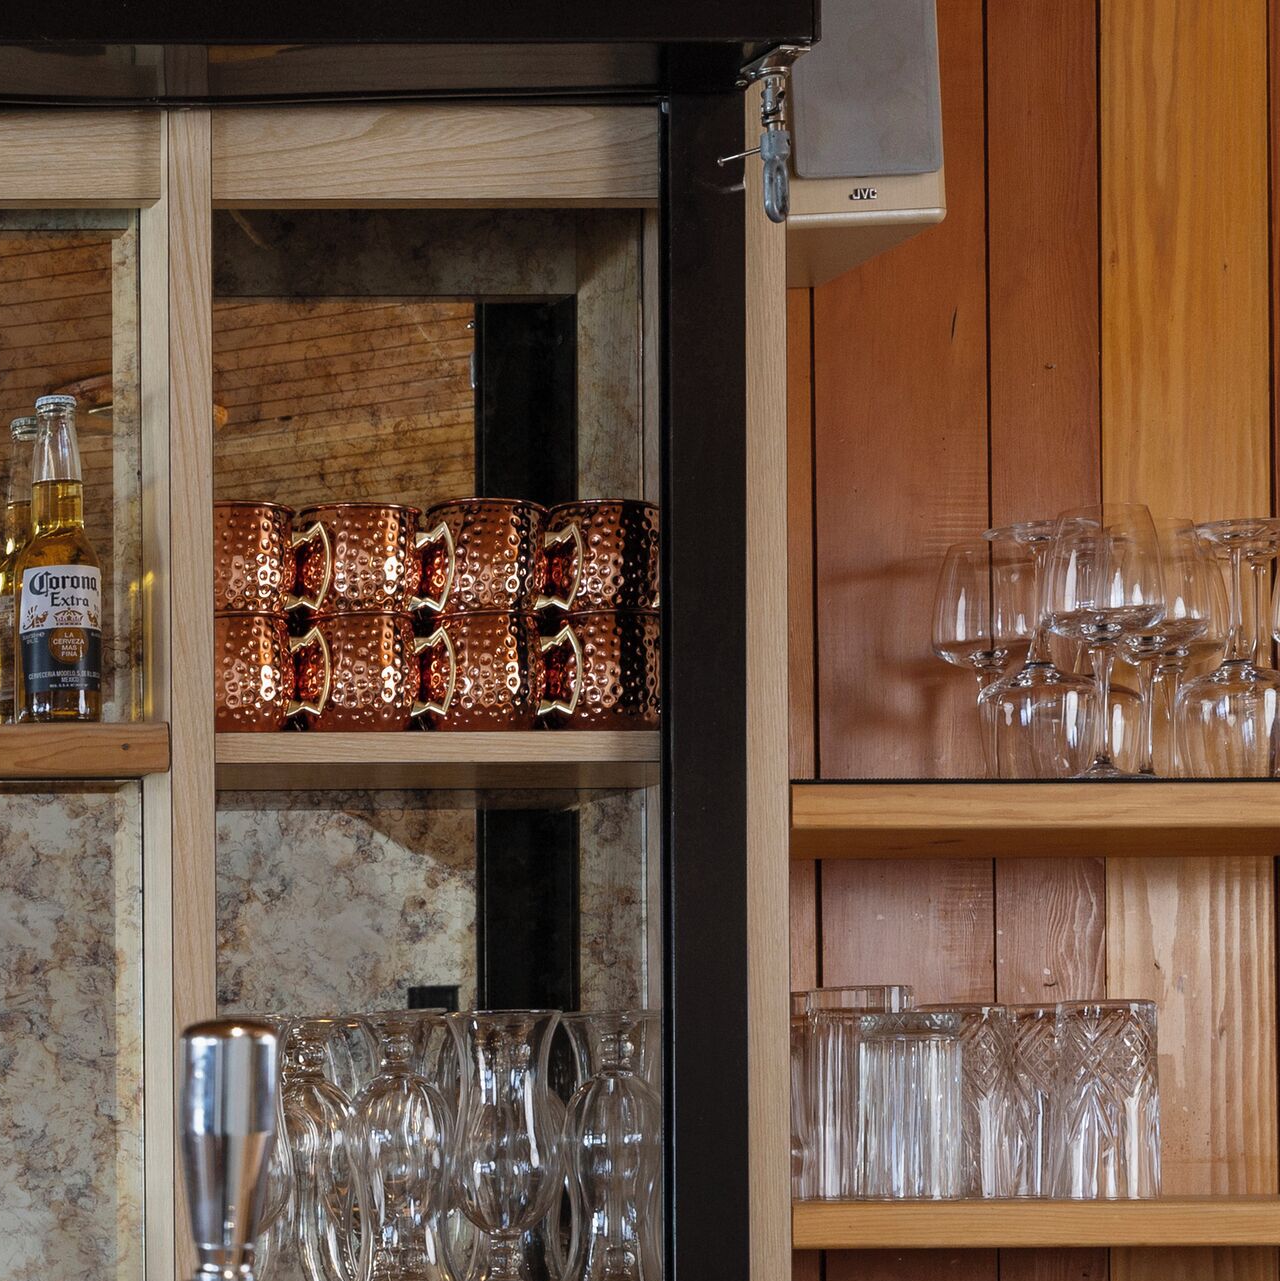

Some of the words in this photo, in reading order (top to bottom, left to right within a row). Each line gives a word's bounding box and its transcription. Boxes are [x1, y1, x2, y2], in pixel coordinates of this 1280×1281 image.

[852, 188, 878, 200] JVC
[29, 571, 98, 597] Corona
[50, 592, 90, 608] Extra
